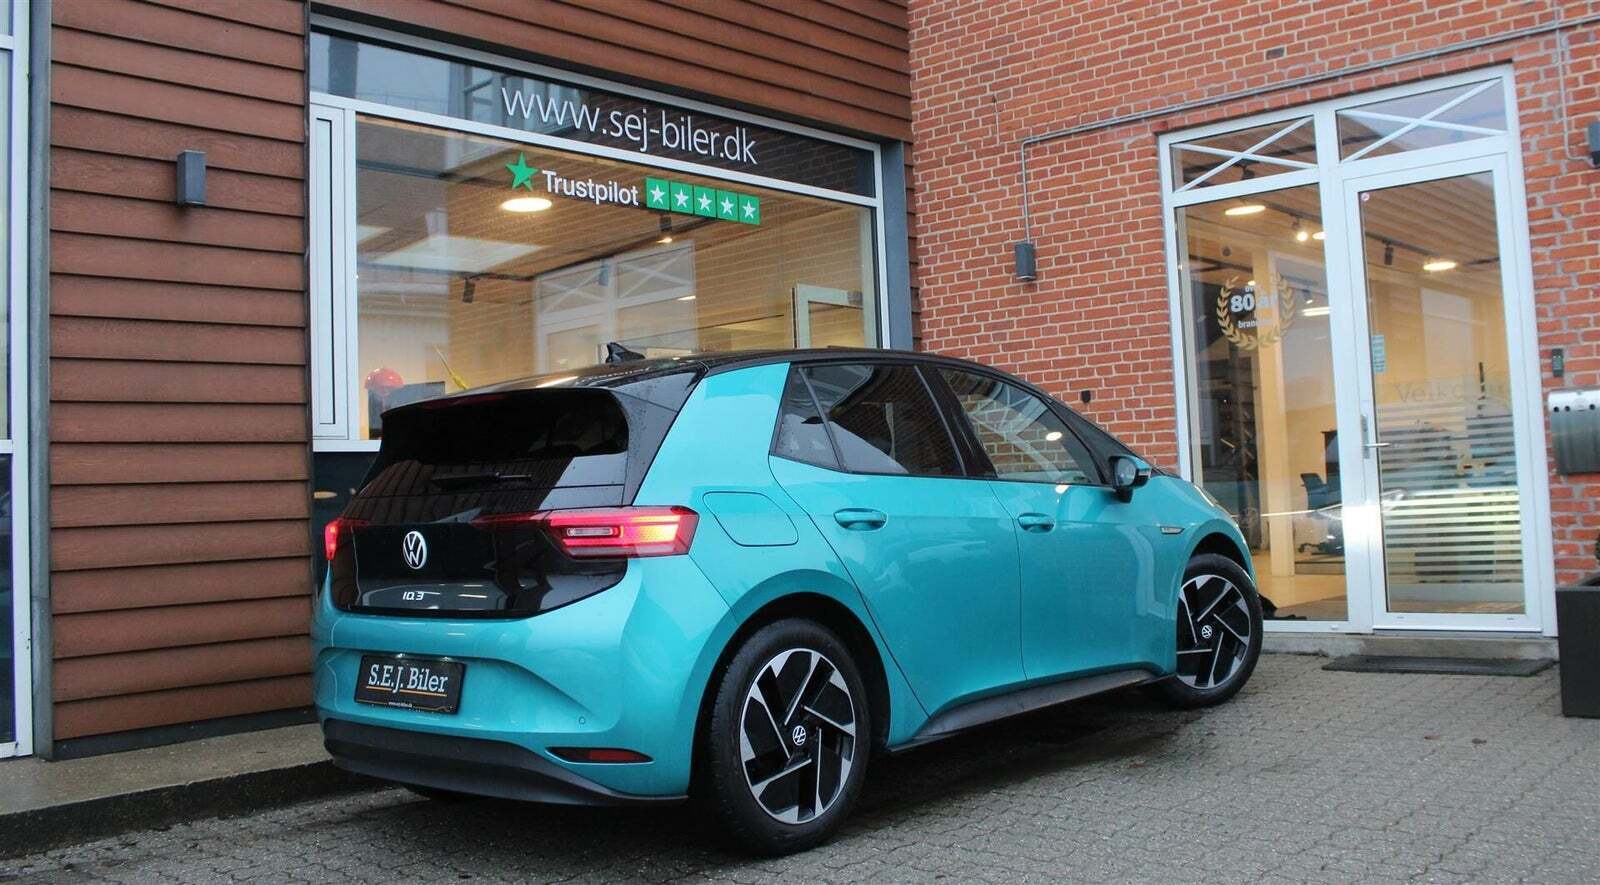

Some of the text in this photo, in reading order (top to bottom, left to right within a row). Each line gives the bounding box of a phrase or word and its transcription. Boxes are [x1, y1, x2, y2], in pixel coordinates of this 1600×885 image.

[501, 87, 759, 165] www.sej-biler.dk
[541, 169, 640, 206] Trustpilot
[1230, 293, 1255, 312] 80
[368, 664, 448, 693] S.E.J. Biler
